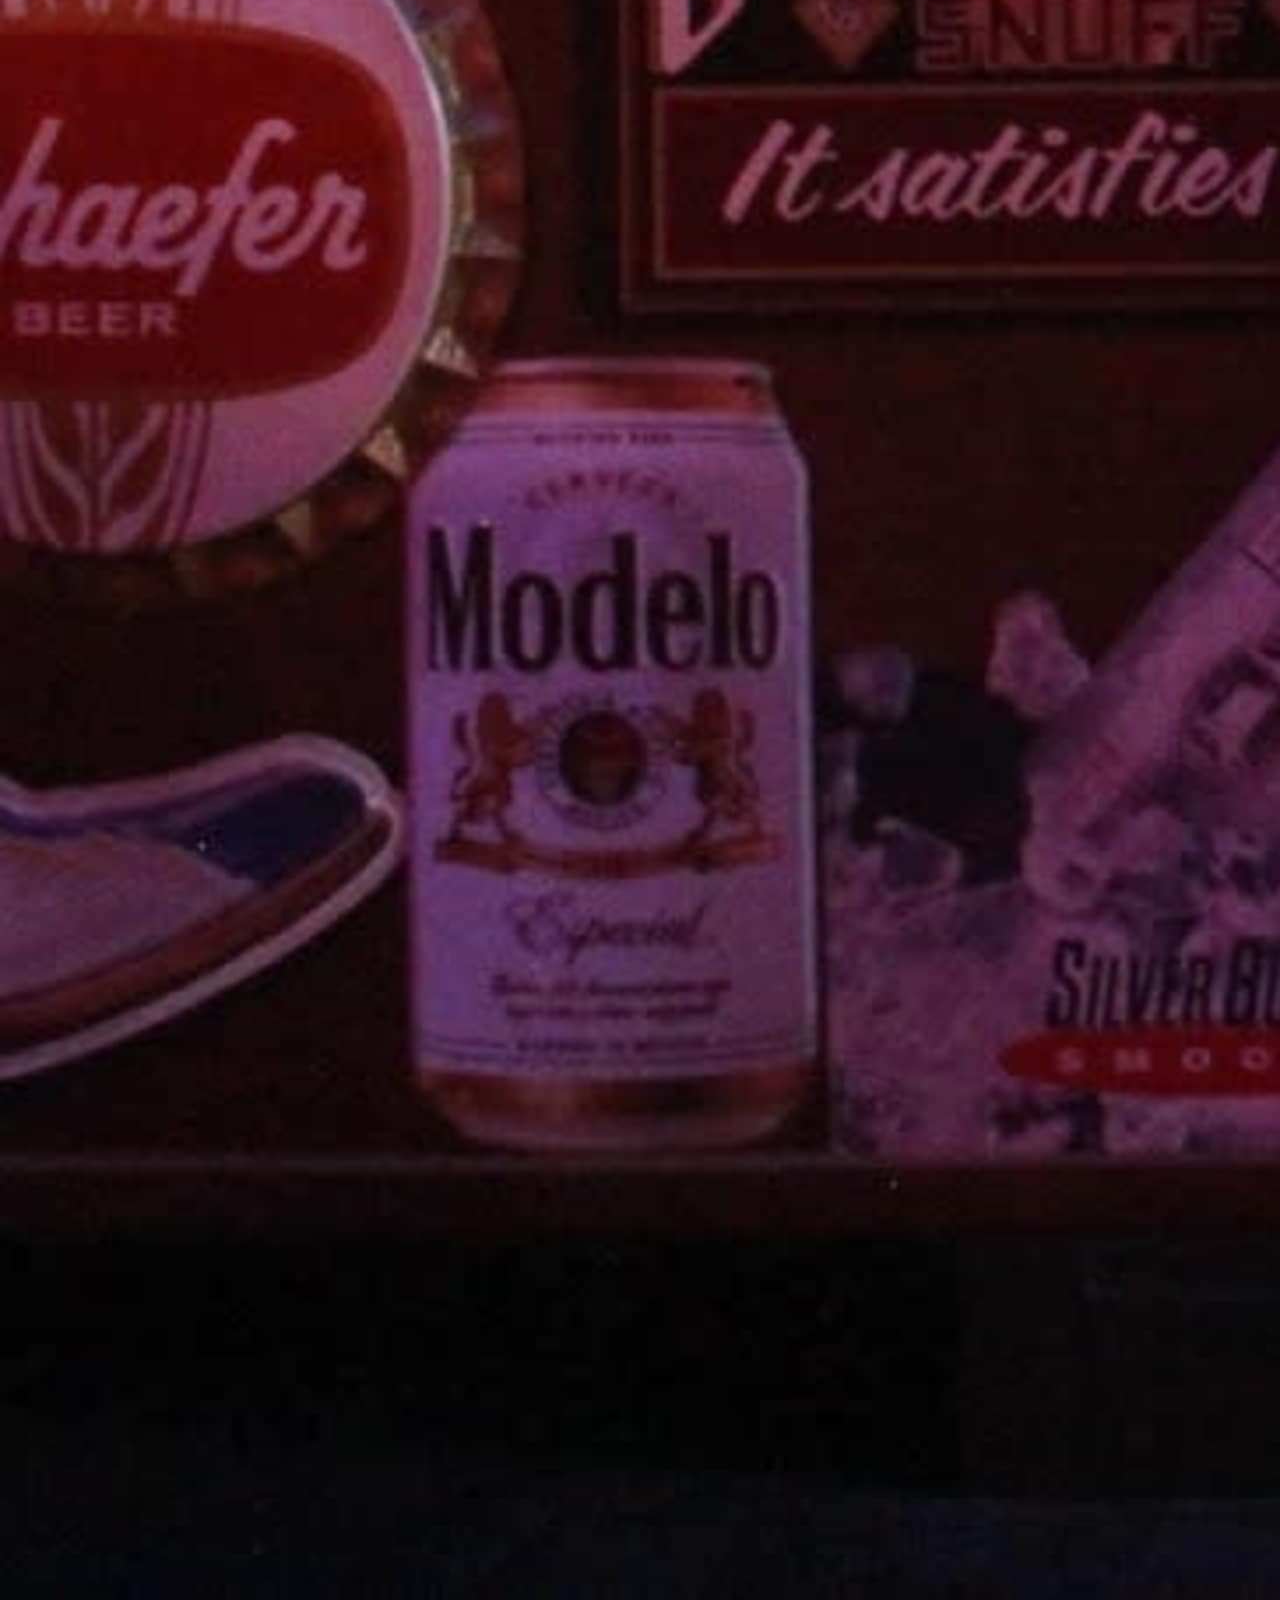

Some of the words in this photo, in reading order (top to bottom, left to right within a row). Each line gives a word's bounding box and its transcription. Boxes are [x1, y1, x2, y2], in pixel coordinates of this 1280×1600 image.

[722, 117, 838, 224] It
[13, 300, 179, 338] BEER
[426, 522, 780, 675] Modelo
[1045, 938, 1215, 1029] SILVER
